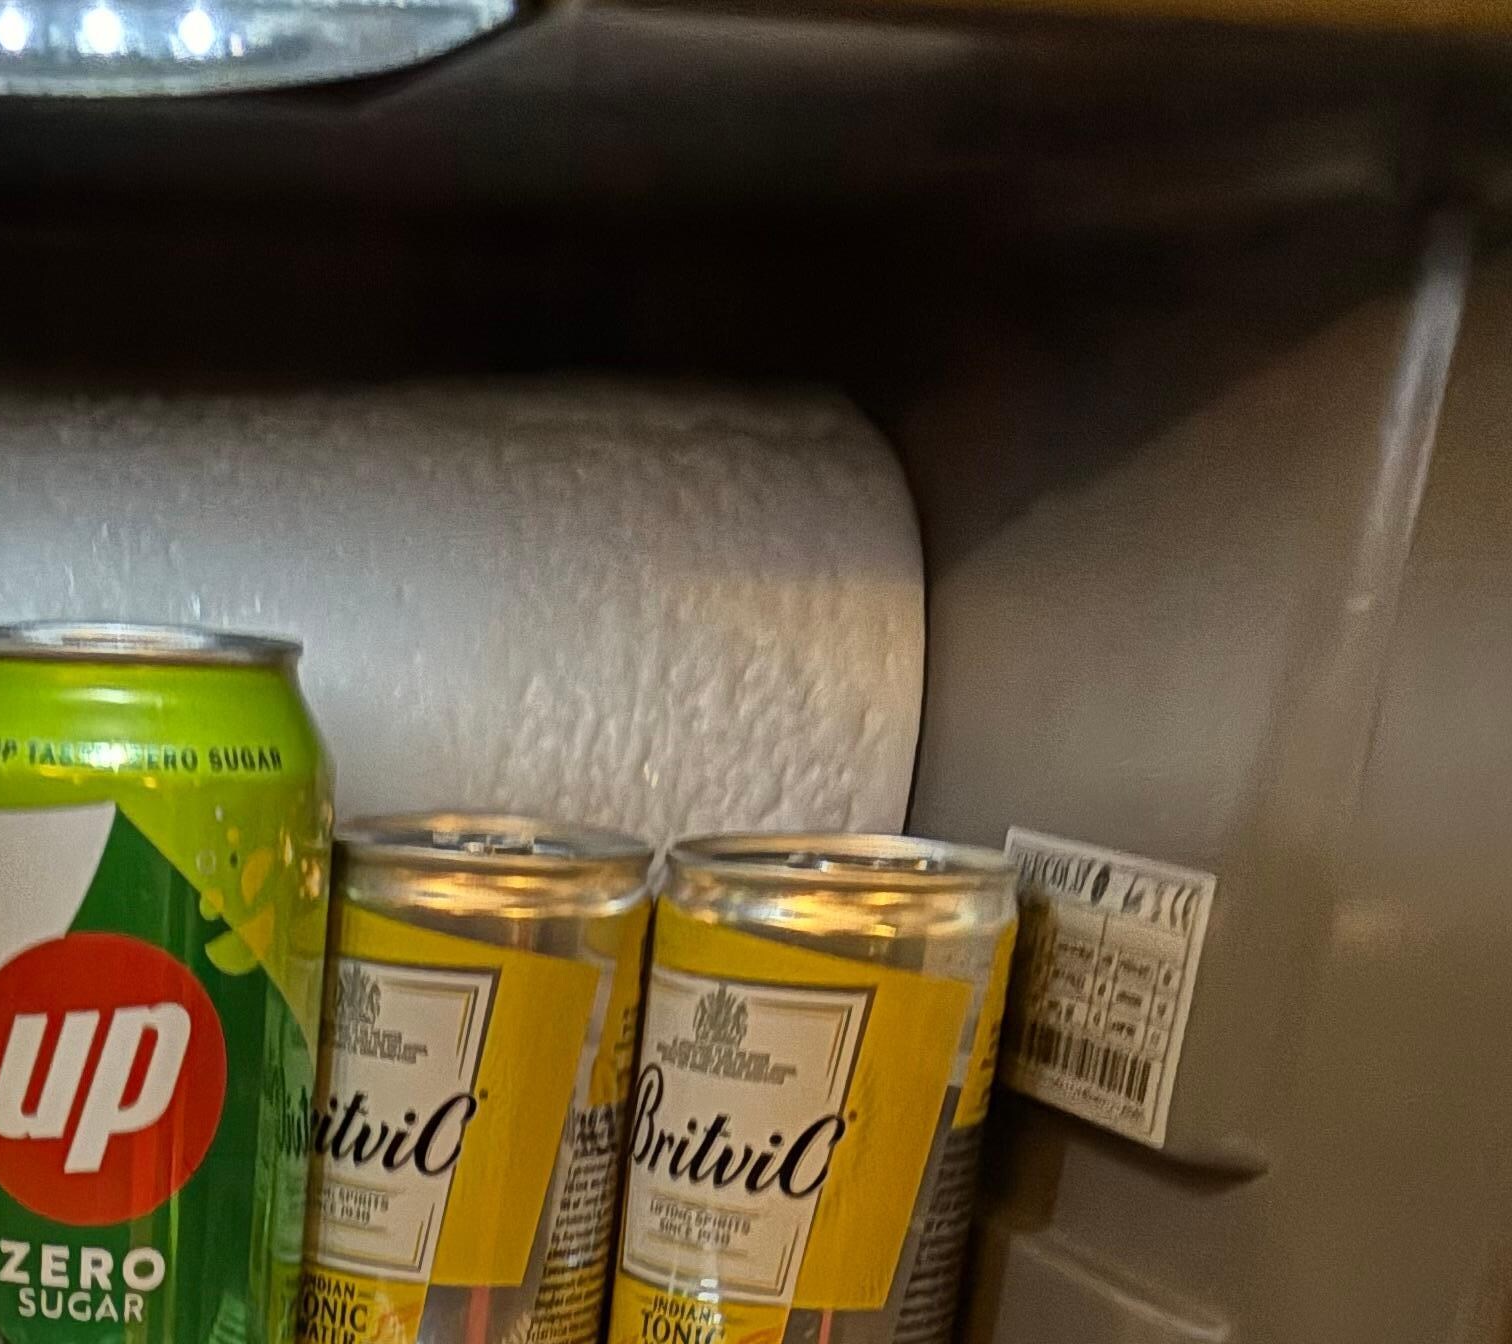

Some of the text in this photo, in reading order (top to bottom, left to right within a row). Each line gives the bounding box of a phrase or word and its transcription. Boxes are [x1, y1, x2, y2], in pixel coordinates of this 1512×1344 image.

[207, 745, 283, 772] SUGAR
[18, 1288, 145, 1323] SUGAR
[303, 1294, 368, 1333] ONIC
[652, 1294, 711, 1324] INDIAN
